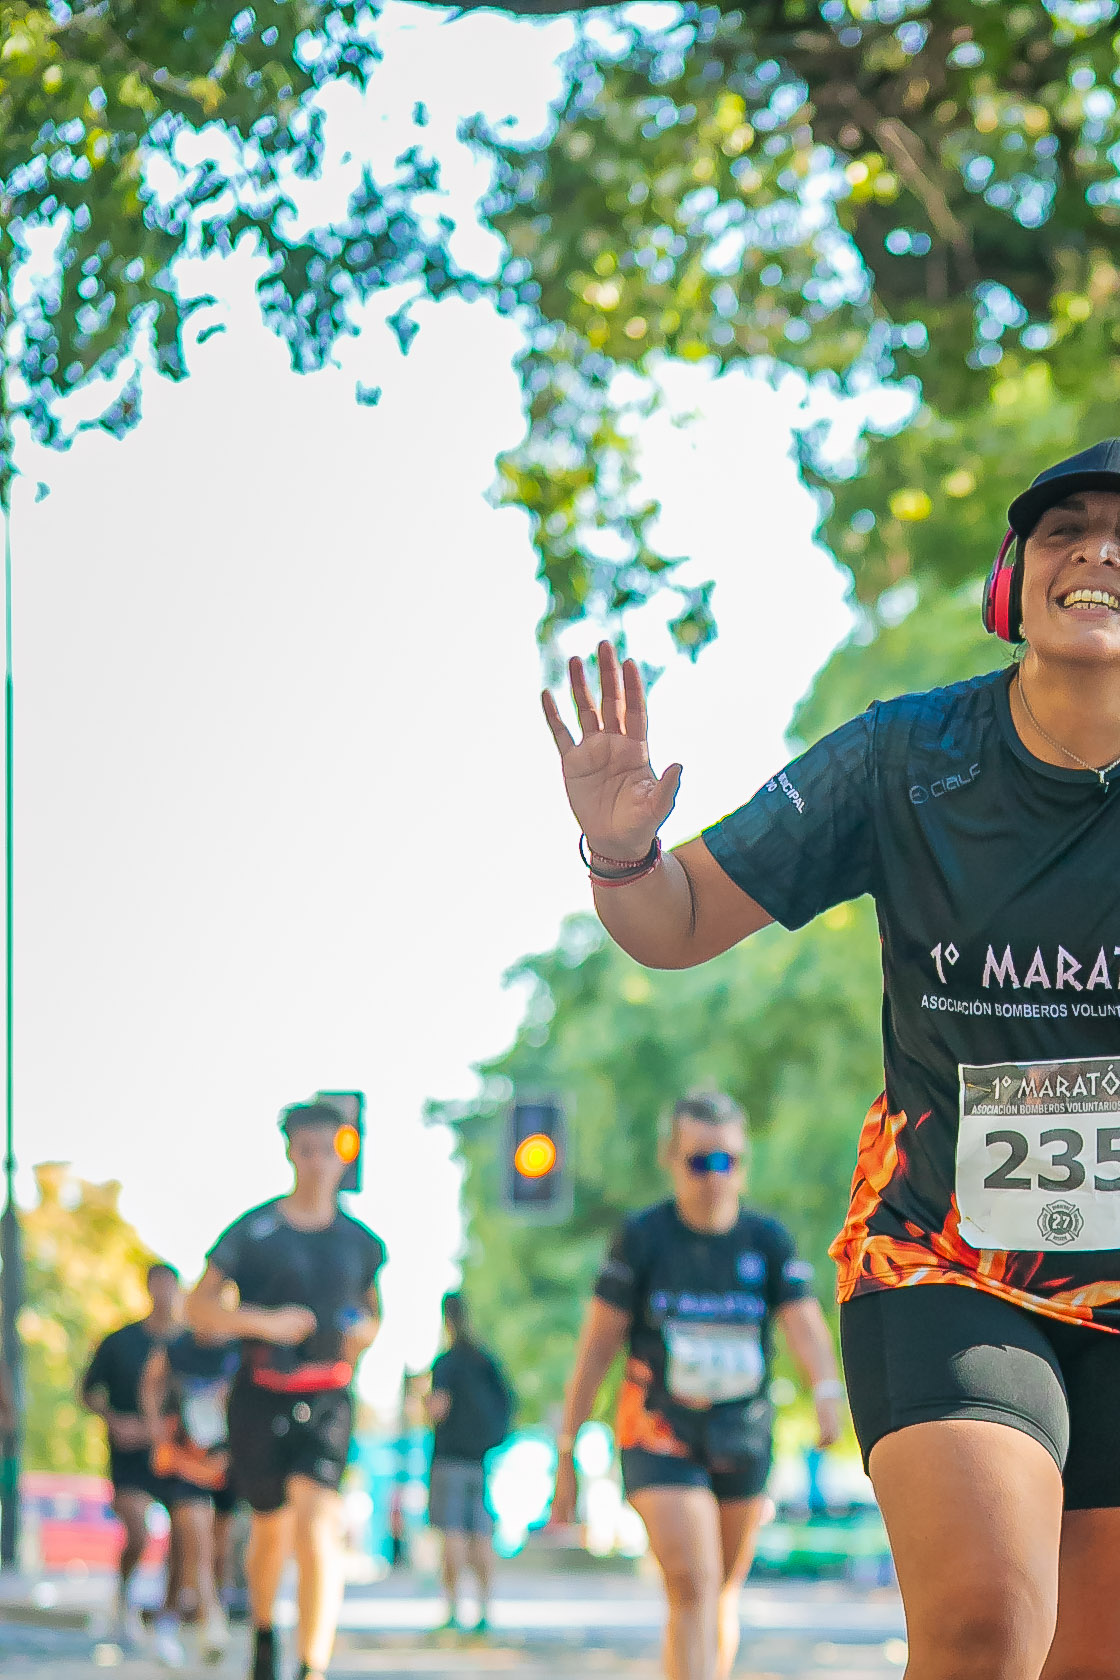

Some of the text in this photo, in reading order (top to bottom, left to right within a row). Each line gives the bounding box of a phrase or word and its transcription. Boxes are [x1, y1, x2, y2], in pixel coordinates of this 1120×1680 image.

[921, 995, 991, 1016] ASOCIACIÓN
[996, 1002, 1067, 1018] BOMBEROS
[972, 1103, 1017, 1115] ASOCIACIÓN
[1019, 1102, 1065, 1114] BOMBEROS
[1052, 1213, 1070, 1229] 27
